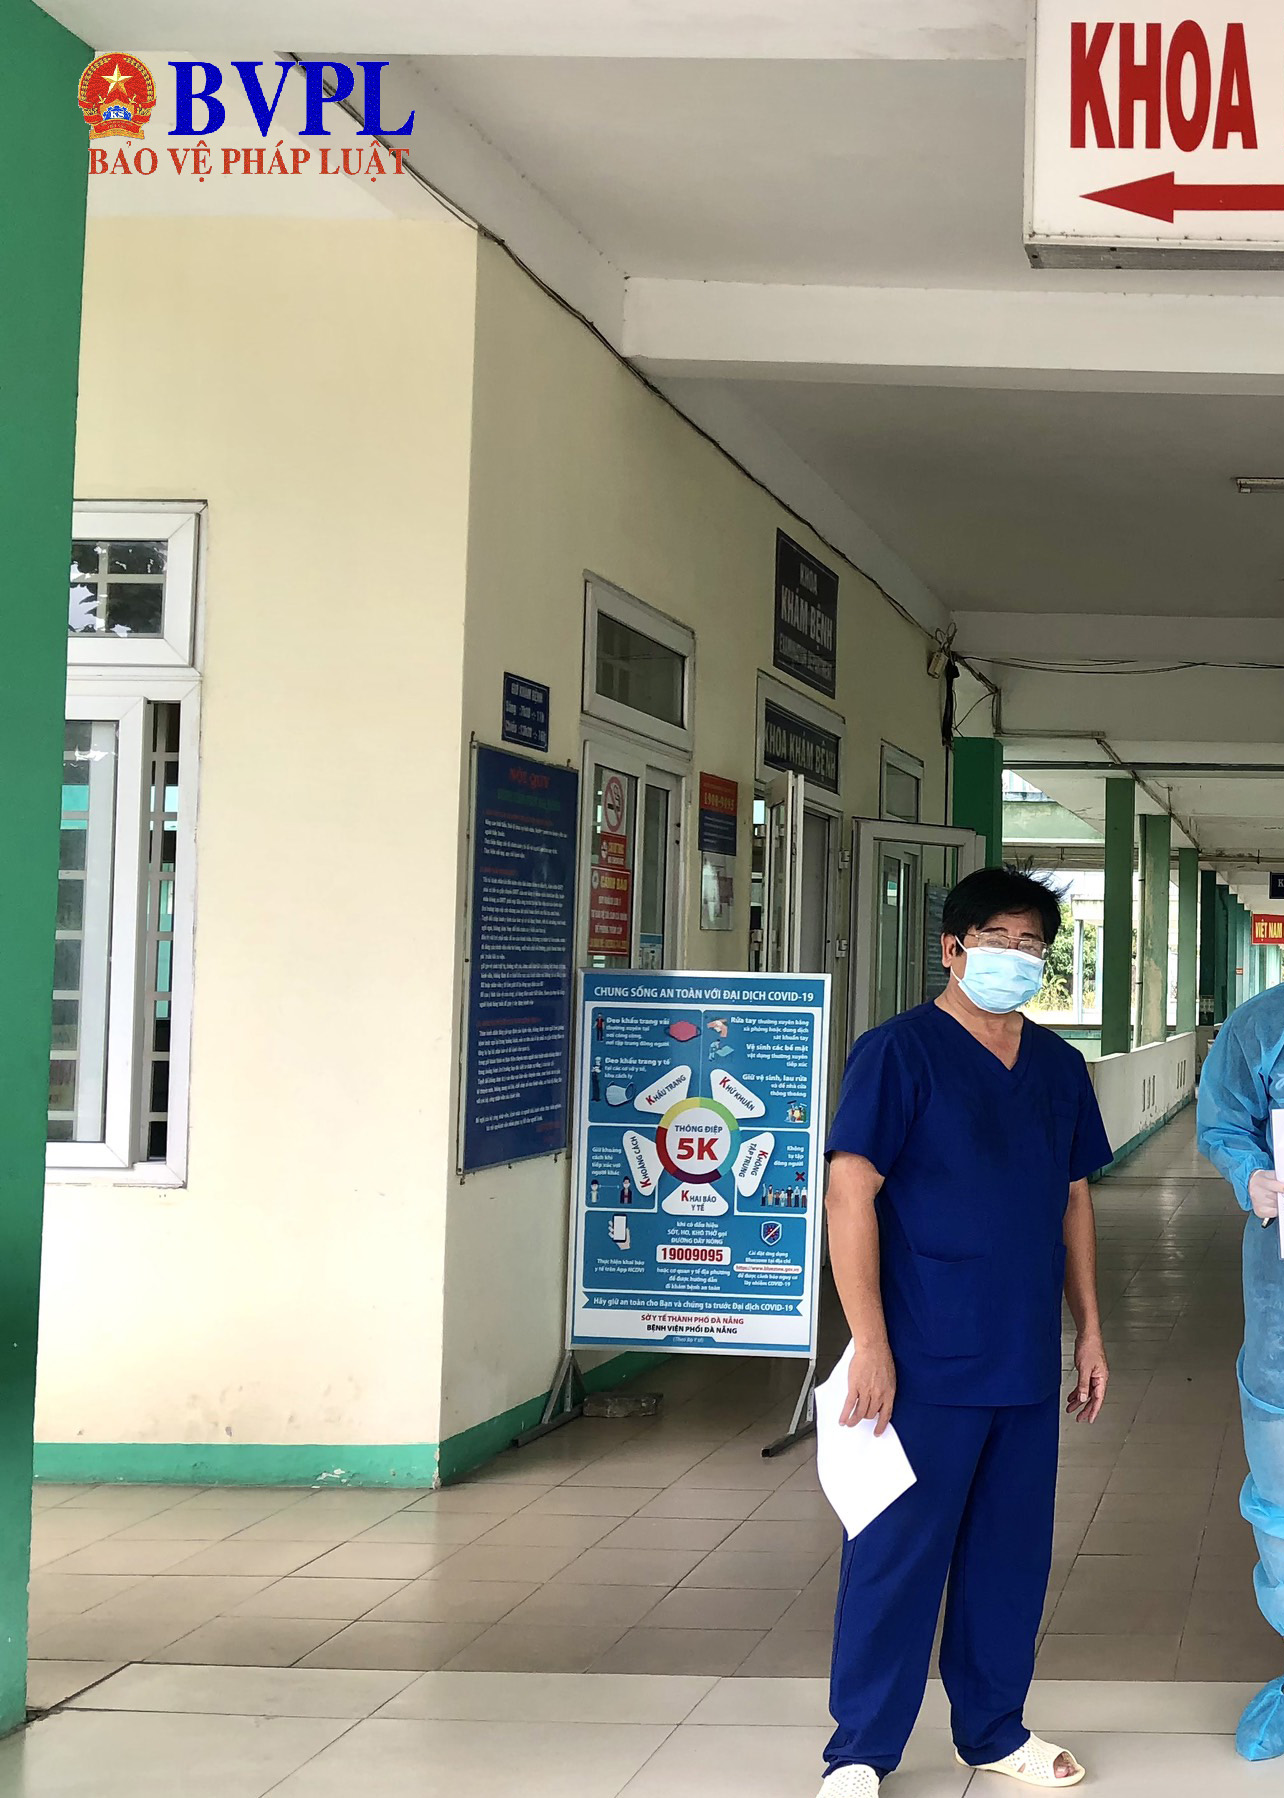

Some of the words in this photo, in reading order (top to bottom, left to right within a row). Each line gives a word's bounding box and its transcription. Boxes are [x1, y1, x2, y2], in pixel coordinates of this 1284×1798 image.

[1071, 19, 1258, 153] KHOA
[781, 584, 808, 635] KHÁM
[810, 603, 832, 651] BỆNH
[766, 721, 786, 760] KHOA
[789, 731, 813, 771] KHÁM
[816, 740, 836, 782] BỆNH
[1255, 919, 1268, 941] VIỆT
[1269, 922, 1282, 938] NAM
[594, 987, 629, 997] CHUNG
[631, 985, 657, 998] SỐNG
[660, 989, 673, 998] AN
[675, 987, 702, 999] TOÀN
[704, 987, 721, 999] VỚI
[723, 990, 740, 1002] ĐẠI
[743, 991, 766, 1002] DỊCH
[768, 991, 814, 1001] COVID-19
[665, 1074, 686, 1092] TRANG
[675, 1124, 704, 1132] THÔNG
[705, 1124, 723, 1135] ĐIỆP
[630, 1136, 641, 1156] CÁCH
[676, 1137, 719, 1161] 5K
[739, 1154, 752, 1178] TRUNG
[751, 1150, 769, 1176] KHÔNG
[681, 1190, 702, 1202] KHAI
[703, 1195, 717, 1203] BÁO
[697, 1204, 705, 1212] TẾ
[661, 1247, 723, 1262] 19009095
[594, 1297, 606, 1306] Hãy
[608, 1298, 619, 1306] giữ
[660, 1300, 672, 1309] Bạn
[683, 1301, 703, 1309] chúng
[732, 1303, 744, 1311] Đại
[745, 1303, 759, 1311] dịch
[641, 1313, 652, 1321] SỞ
[658, 1314, 667, 1322] TẾ
[668, 1314, 693, 1322] THÀNH
[694, 1315, 709, 1323] PHỐ
[711, 1316, 721, 1324] ĐÀ
[647, 1324, 666, 1333] BỆNH
[668, 1324, 684, 1333] VIỆN
[685, 1325, 703, 1333] PHỔI
